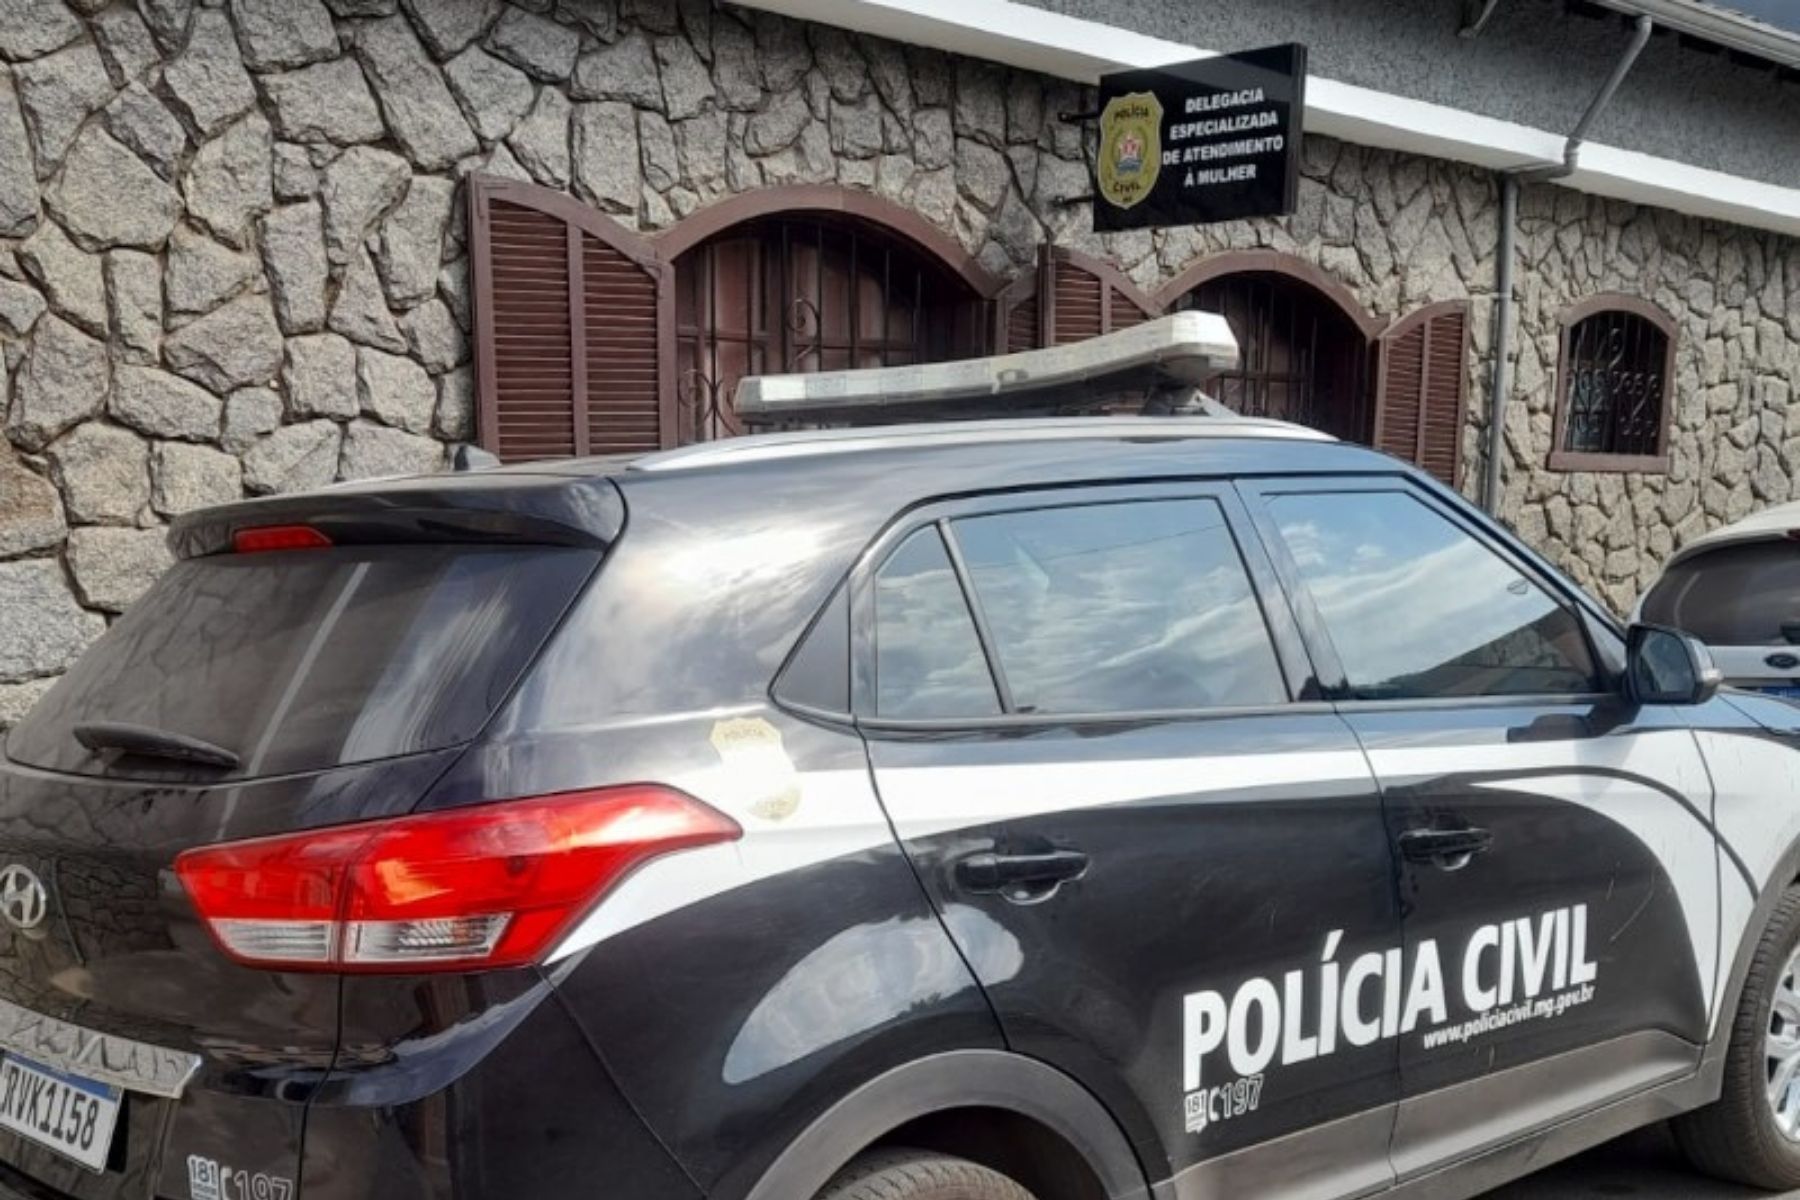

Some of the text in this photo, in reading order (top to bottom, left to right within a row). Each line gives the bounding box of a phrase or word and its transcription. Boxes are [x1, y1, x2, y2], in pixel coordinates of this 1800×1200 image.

[1185, 87, 1264, 114] DELEGACIA
[1169, 110, 1279, 140] ESPECIALIZADA
[1162, 134, 1283, 165] DE ATENDIMENTO
[1197, 164, 1257, 184] MULHER
[1183, 903, 1598, 1092] POLÍCIA CIVIL
[1423, 983, 1596, 1049] www.policiacivil.mg.gov.br
[1220, 1073, 1264, 1119] 197
[189, 1156, 217, 1184] 181
[233, 1169, 293, 1200] 197
